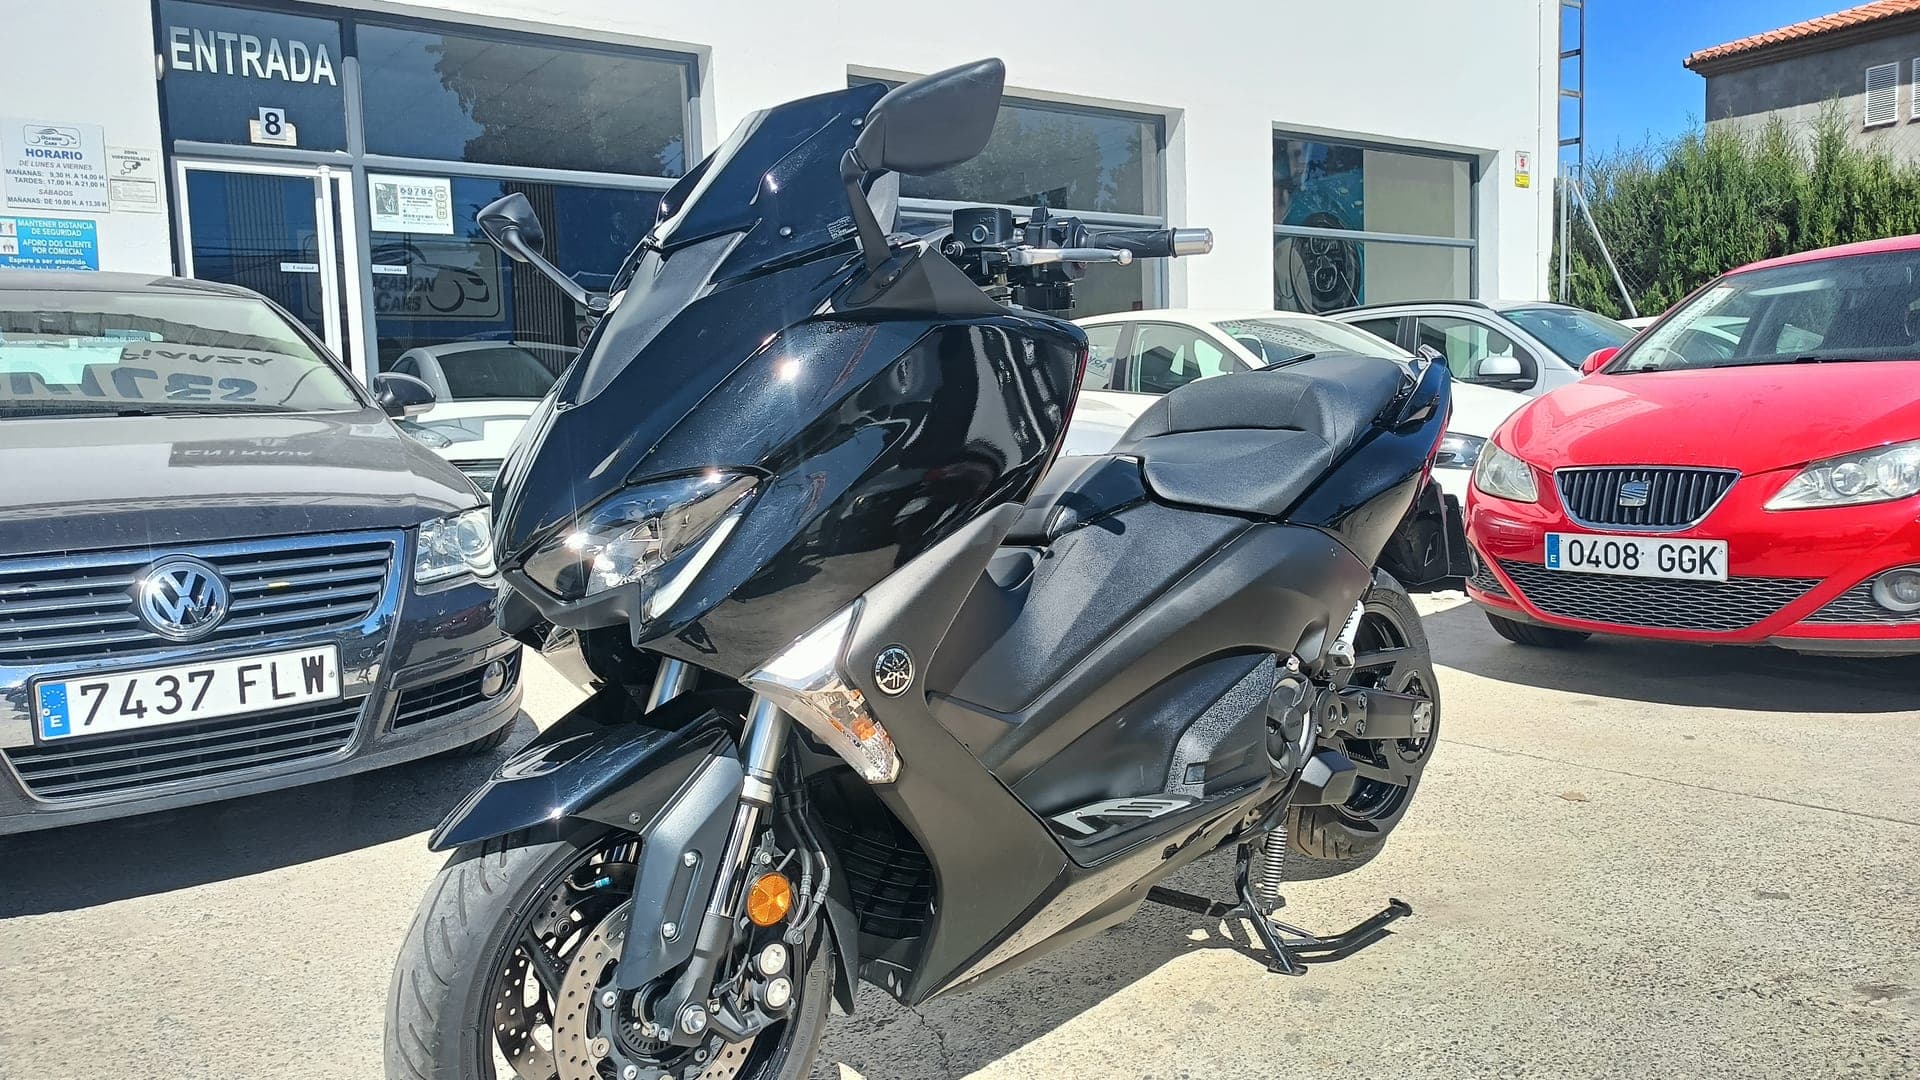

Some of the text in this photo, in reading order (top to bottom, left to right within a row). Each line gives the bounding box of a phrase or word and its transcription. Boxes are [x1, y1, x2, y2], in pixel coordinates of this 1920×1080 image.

[169, 26, 337, 86] ENTRADA
[264, 112, 281, 136] 8
[25, 148, 83, 160] HORARIO
[17, 219, 94, 230] MANTENER DISTANCIA
[31, 227, 82, 237] DE SEGURIDAD
[22, 239, 92, 249] AFORO DOS CLIENTE
[32, 246, 47, 254] POR
[8, 256, 34, 265] Espere
[373, 277, 438, 293] CASION
[1550, 539, 1719, 576] E 0408 GGK
[50, 654, 325, 728] E 7437 FLW
